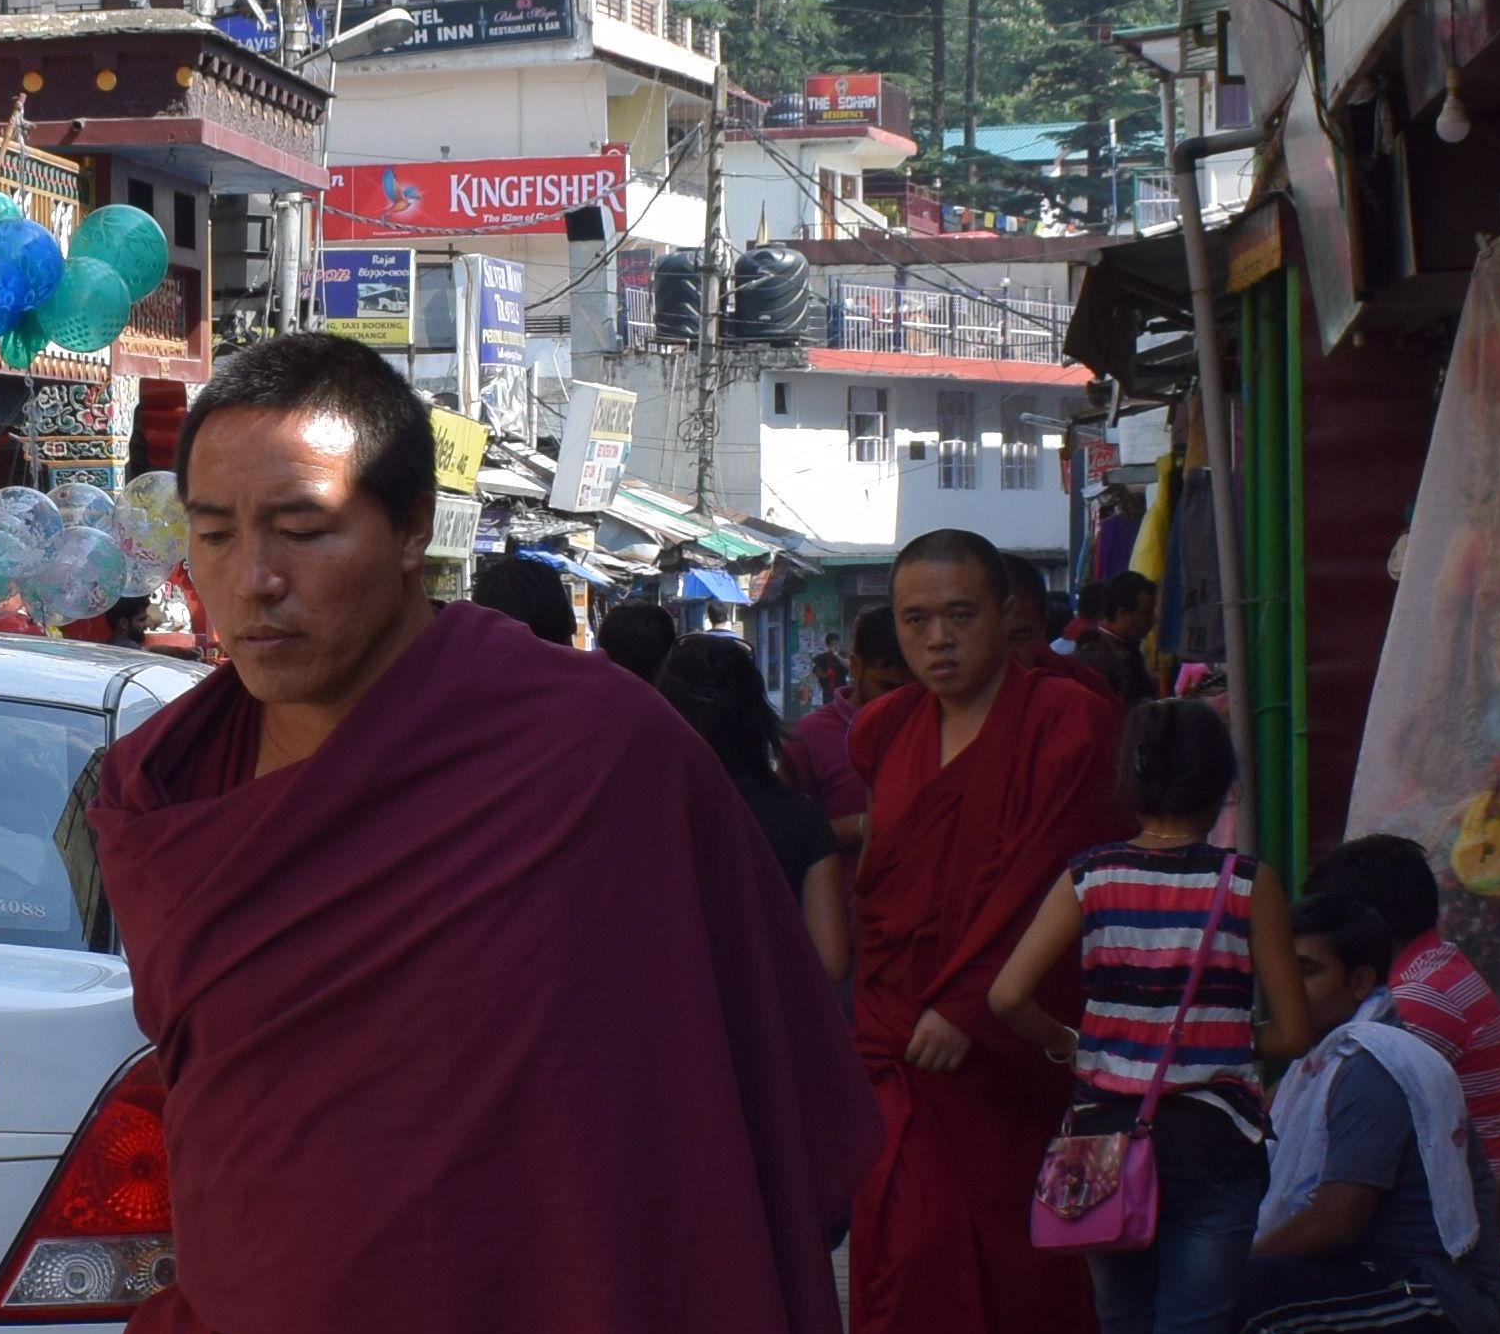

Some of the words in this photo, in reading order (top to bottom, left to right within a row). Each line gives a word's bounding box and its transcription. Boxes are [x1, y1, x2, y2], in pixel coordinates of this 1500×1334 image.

[437, 24, 474, 42] INN
[807, 96, 831, 110] THE
[450, 170, 624, 217] KINGFISHER
[483, 213, 500, 223] The
[342, 322, 360, 330] TAXI
